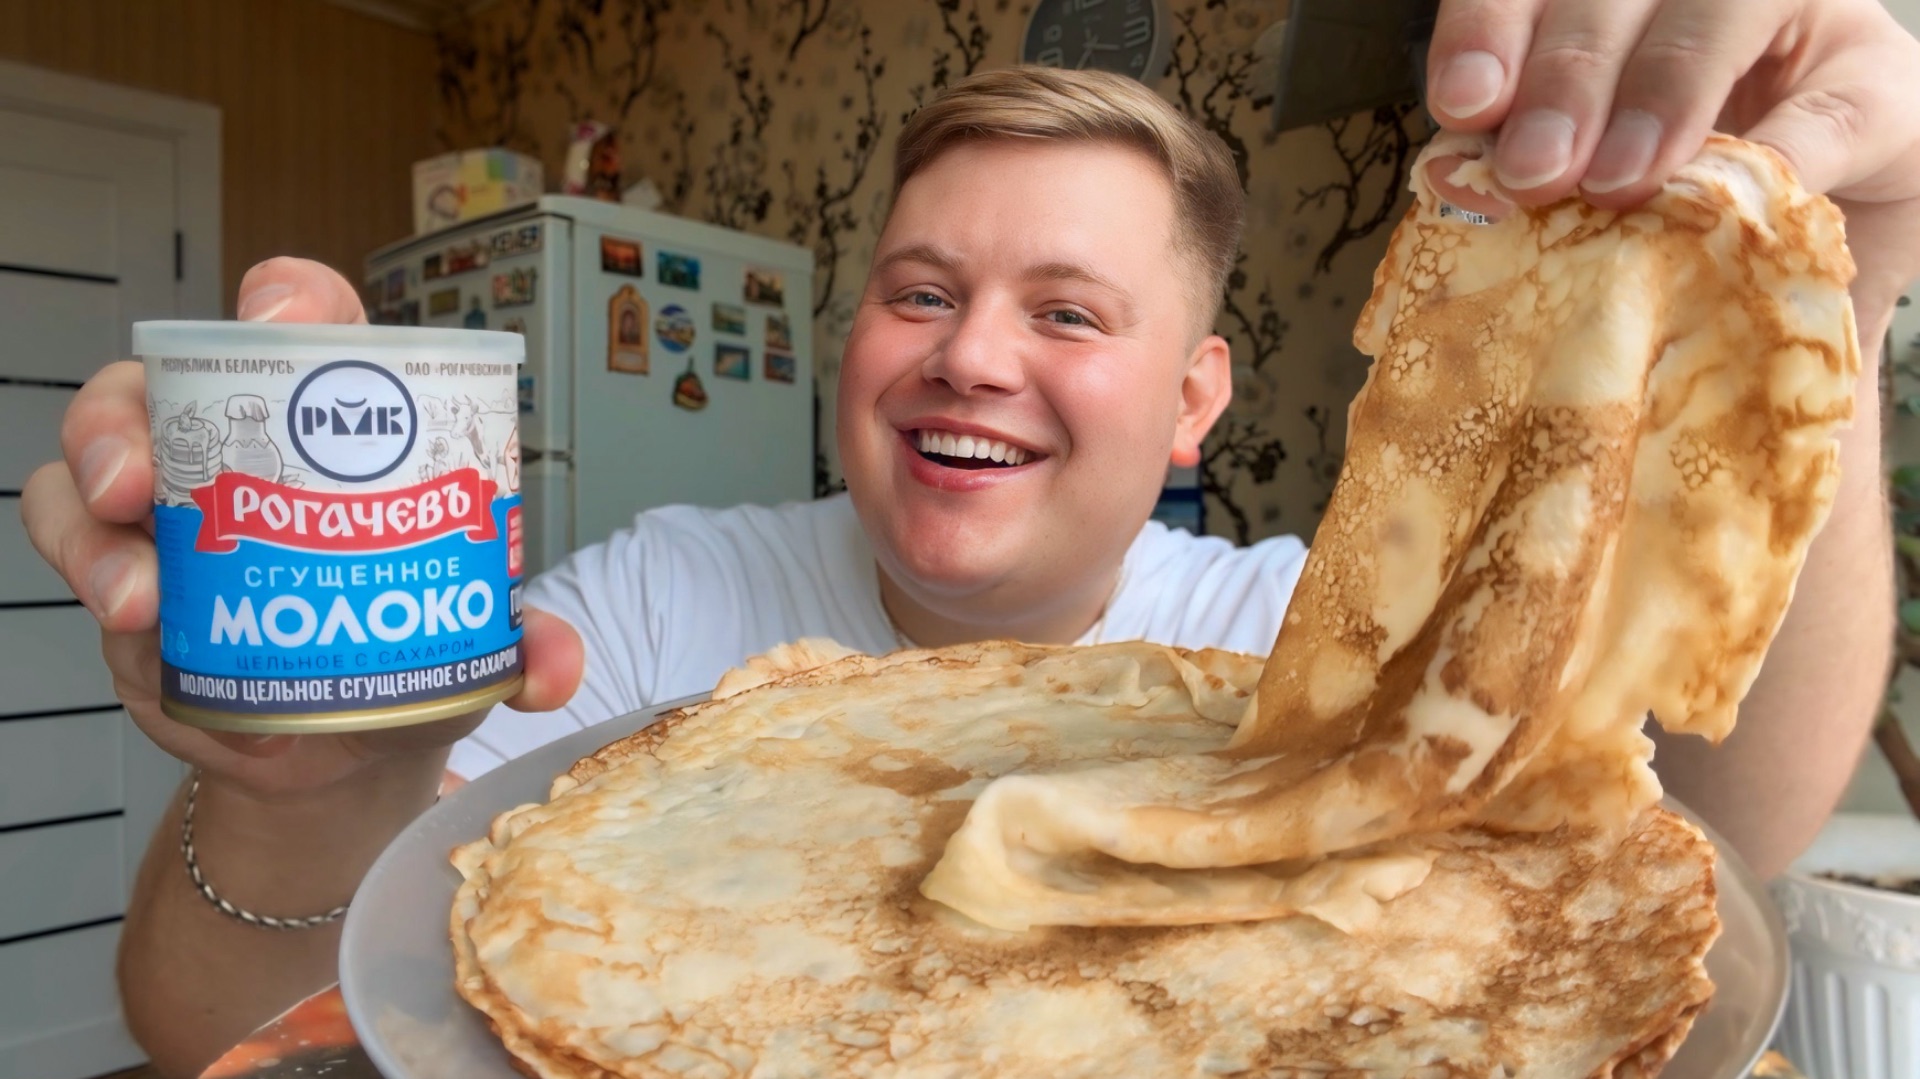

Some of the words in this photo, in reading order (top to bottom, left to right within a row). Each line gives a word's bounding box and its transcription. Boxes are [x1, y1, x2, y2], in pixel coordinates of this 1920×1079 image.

[1123, 16, 1151, 48] 3
[225, 359, 295, 376] БЕЛАРУСЬ
[405, 362, 430, 376] ОАО
[244, 556, 461, 589] СГУЩЕННОЕ
[210, 579, 495, 648] МОЛОКО
[236, 655, 345, 672] ЦЕЛЬНОЕ
[355, 653, 367, 668] С
[378, 638, 476, 666] САХАРОМ
[179, 675, 237, 701] МОЛОКО
[242, 678, 334, 705] ЦЕЛЬНОЕ
[339, 666, 453, 701] СГУЩЕННОЕ
[456, 662, 468, 684] С
